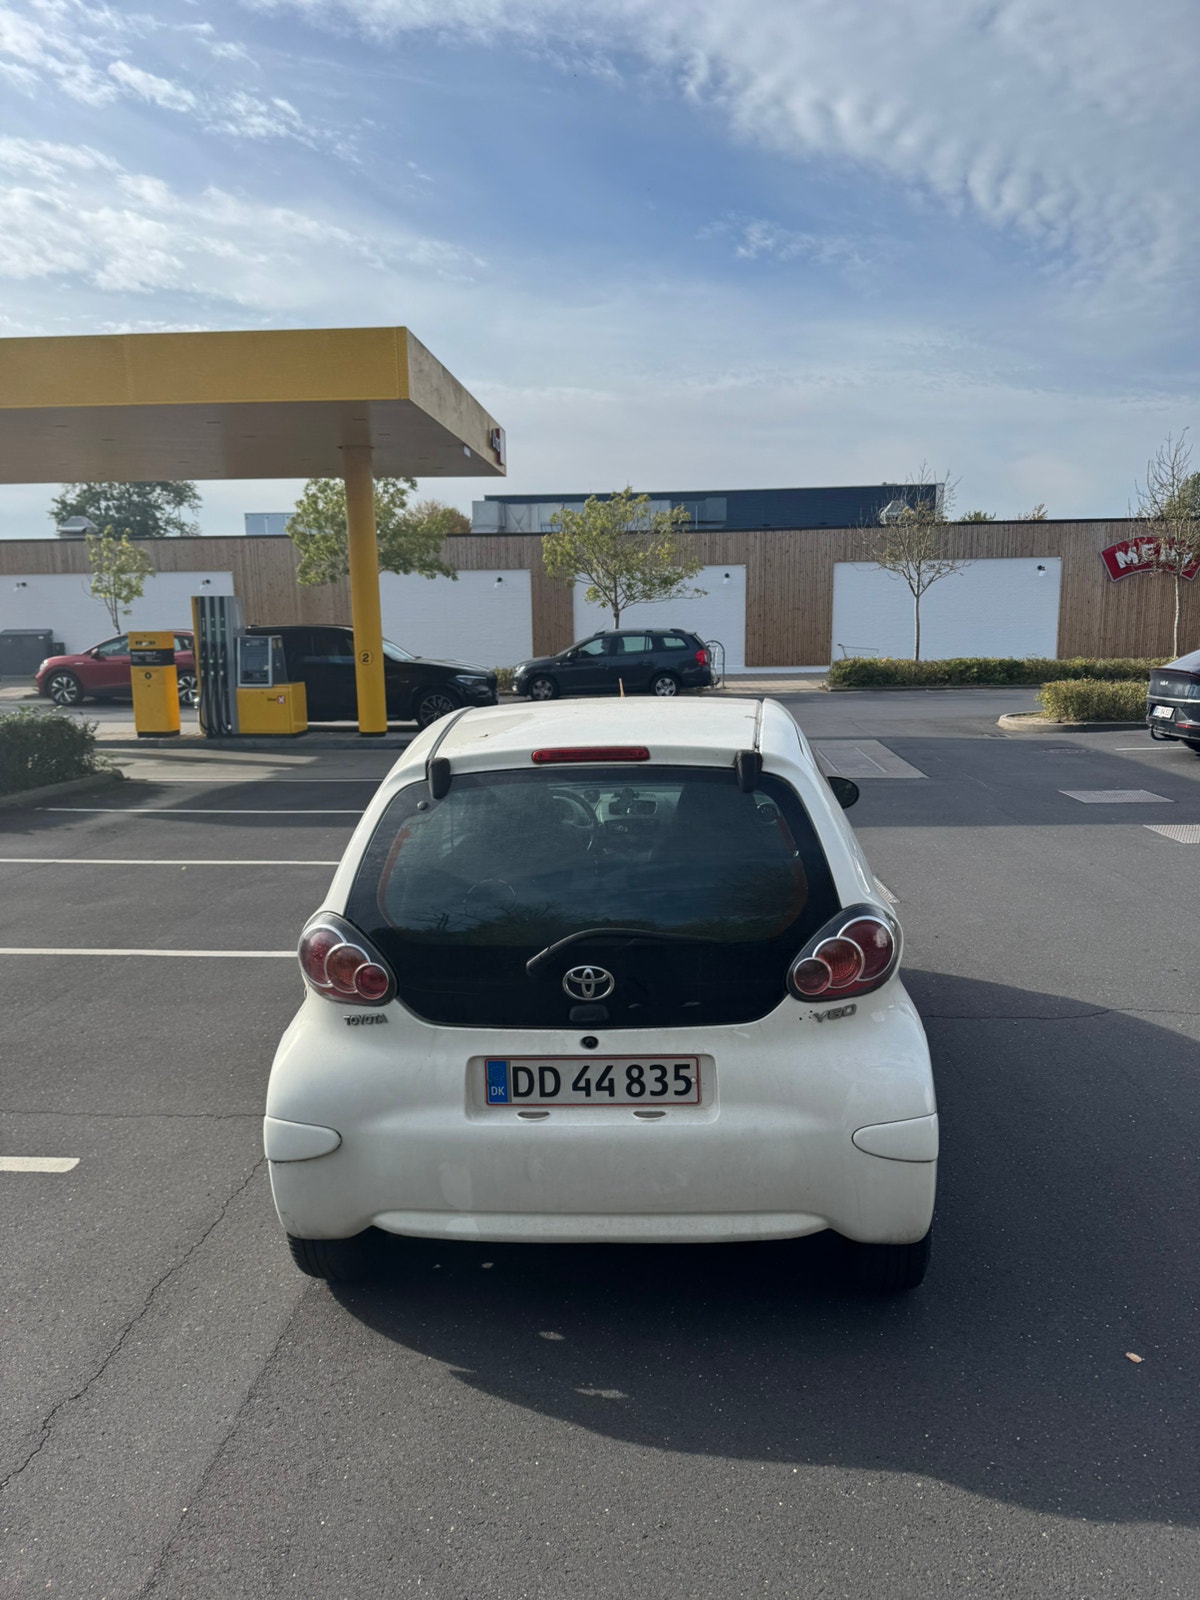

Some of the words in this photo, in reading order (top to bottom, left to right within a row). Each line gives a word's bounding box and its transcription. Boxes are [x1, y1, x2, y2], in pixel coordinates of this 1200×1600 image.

[362, 652, 370, 663] 2
[343, 1013, 389, 1026] TOYOTA
[512, 1066, 561, 1098] DD
[572, 1065, 615, 1098] 44
[625, 1064, 692, 1098] 835
[490, 1086, 505, 1096] DK
